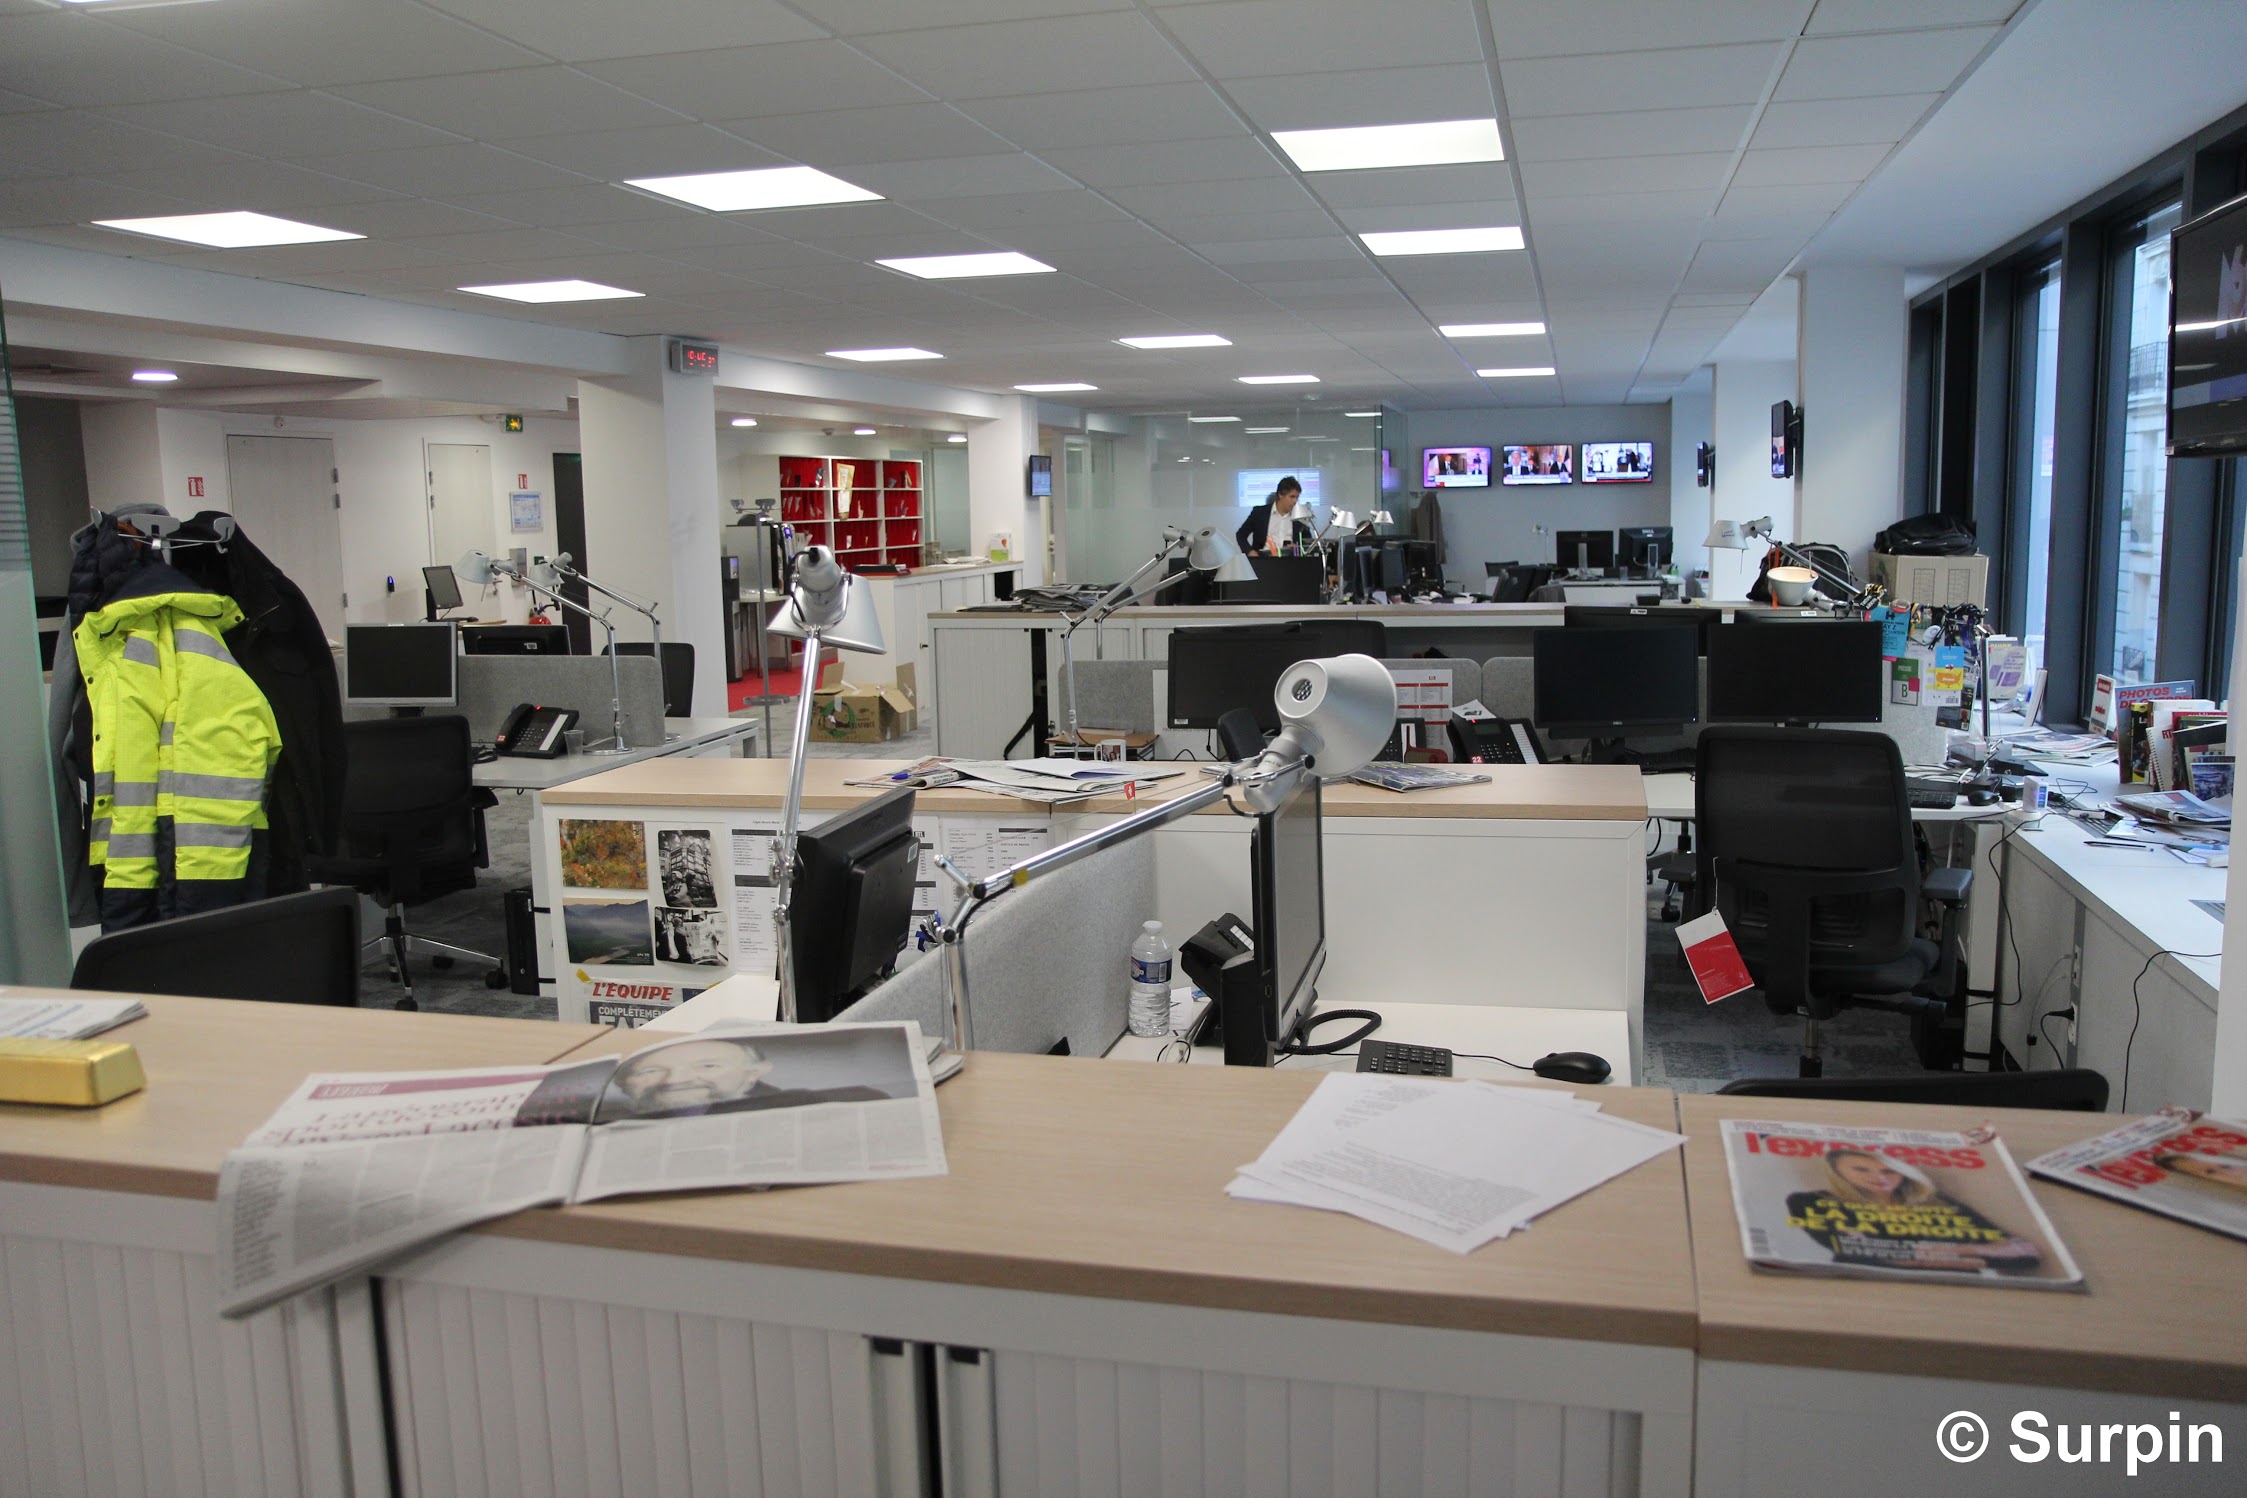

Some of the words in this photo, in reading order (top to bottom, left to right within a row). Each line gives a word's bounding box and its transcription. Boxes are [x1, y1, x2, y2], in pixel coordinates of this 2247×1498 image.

[1902, 684, 1908, 698] B
[2119, 687, 2169, 699] PHOTOS
[2162, 729, 2175, 739] RT
[598, 1005, 672, 1018] COMPLÈTEMEN
[1805, 1206, 1848, 1221] LA
[1855, 1210, 1974, 1228] DROITE
[1786, 1216, 1828, 1231] DE
[1833, 1219, 1879, 1235] LA
[1885, 1223, 2005, 1243] DROITE
